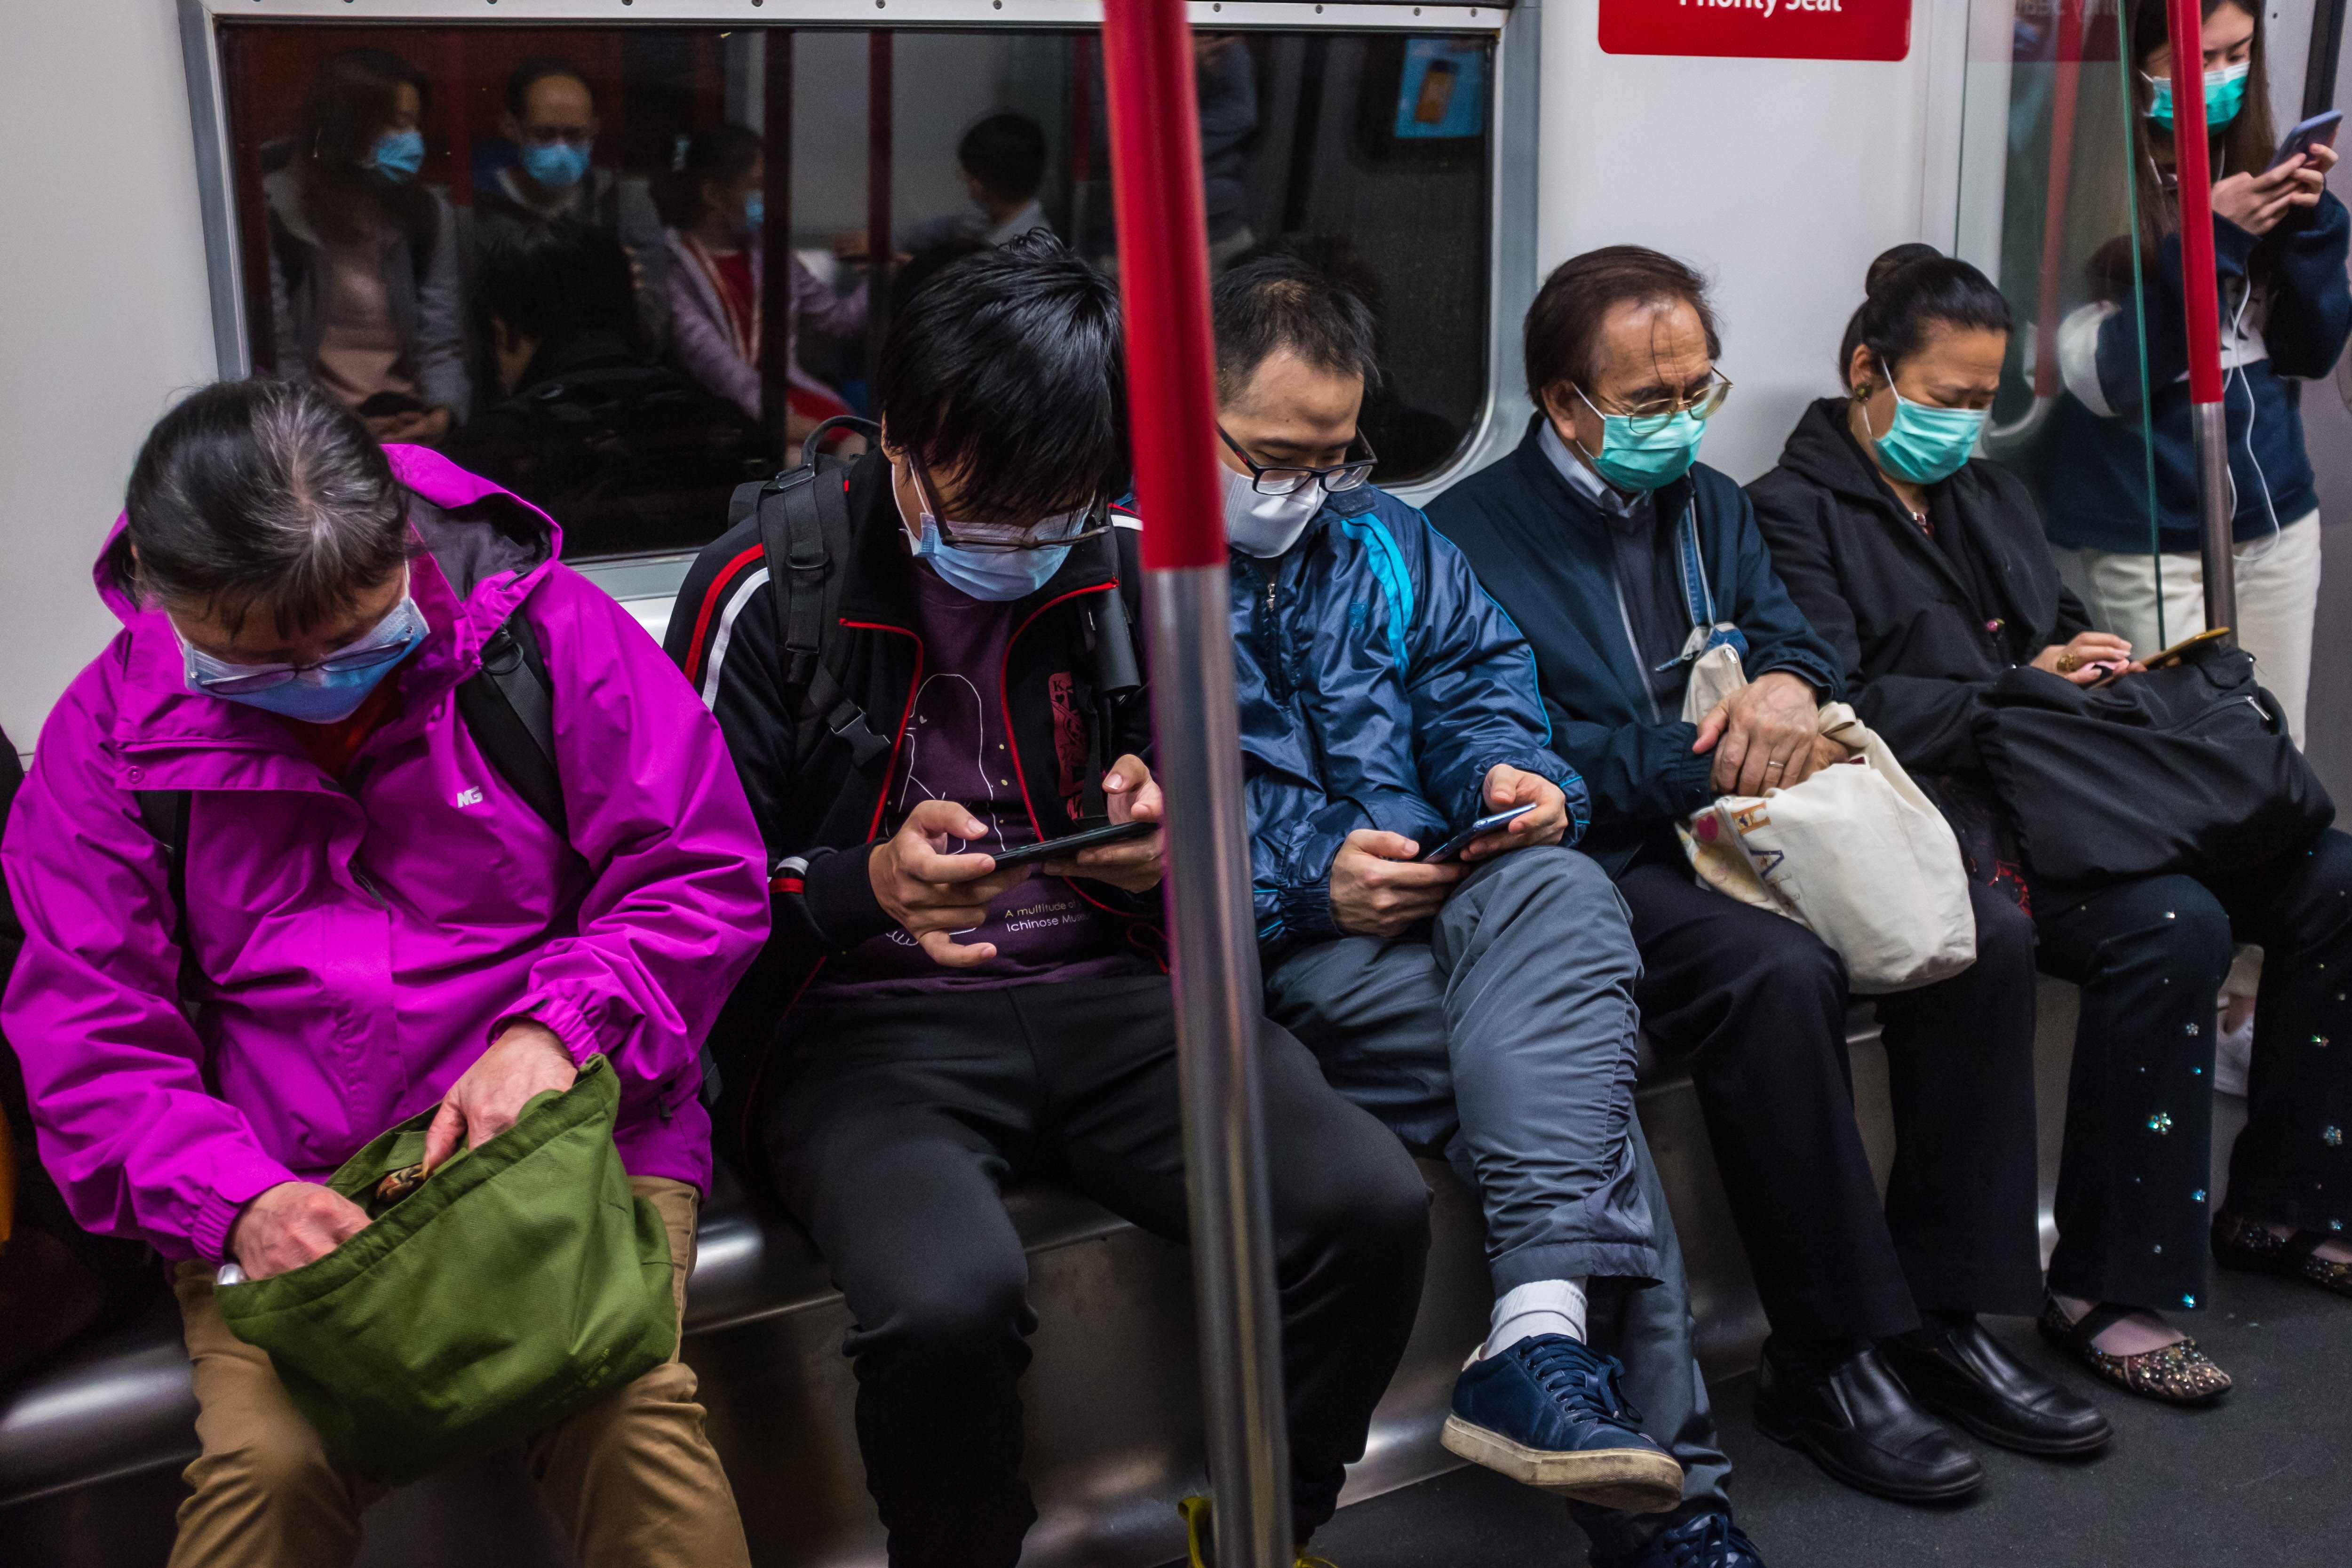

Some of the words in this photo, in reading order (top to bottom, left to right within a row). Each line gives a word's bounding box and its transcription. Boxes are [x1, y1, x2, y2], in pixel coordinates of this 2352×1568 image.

[1005, 909, 1014, 919] A
[1017, 903, 1066, 916] multitude
[1006, 917, 1059, 932] Ichinose
